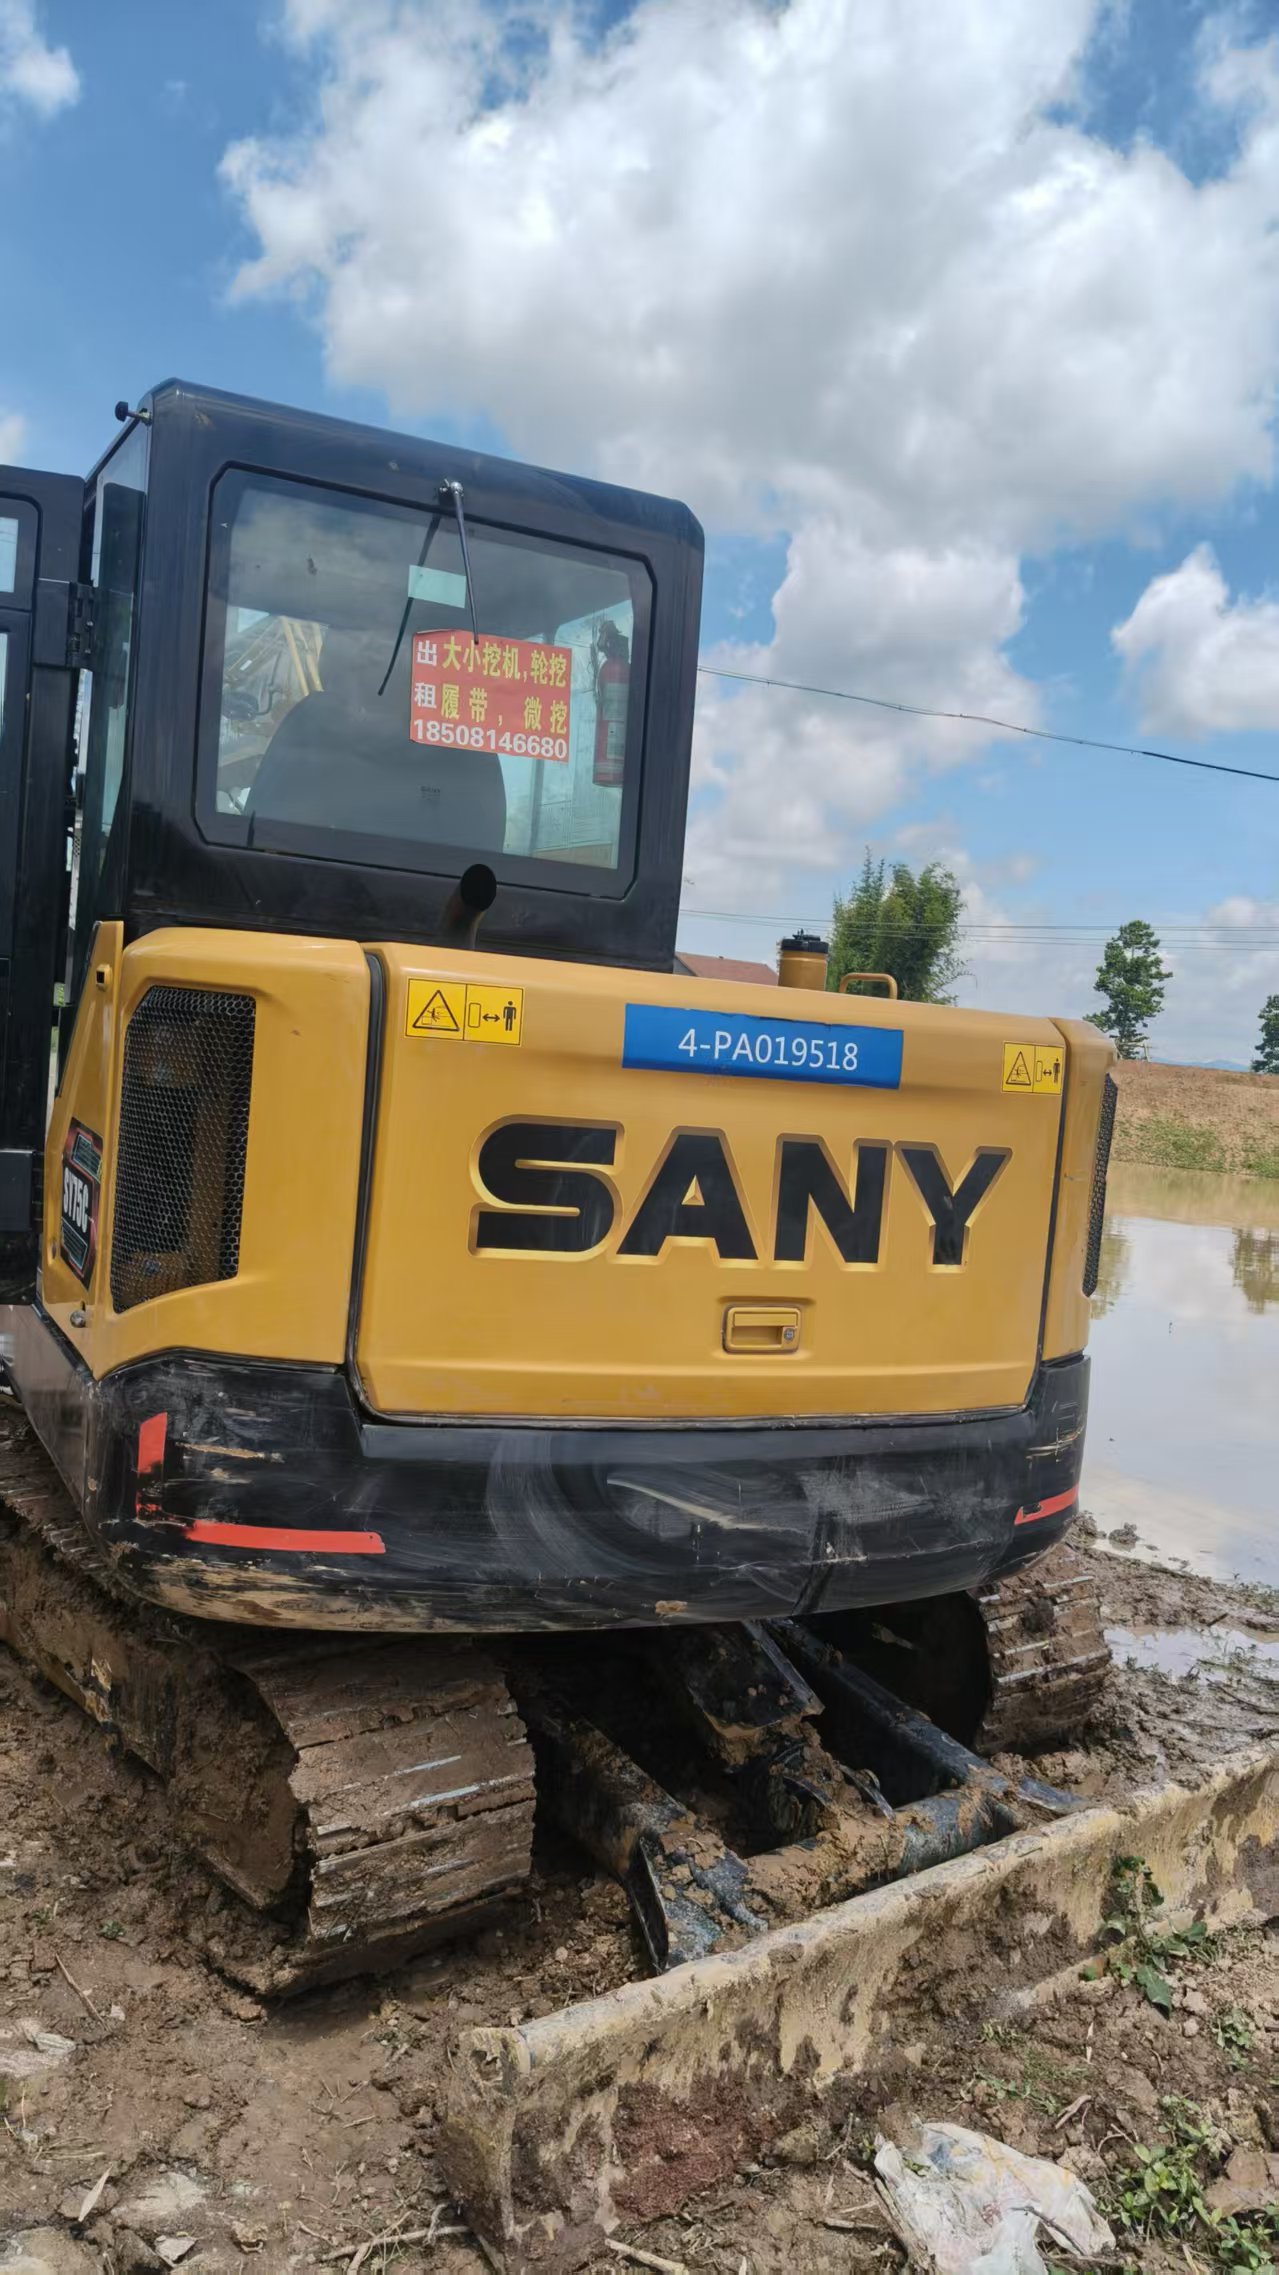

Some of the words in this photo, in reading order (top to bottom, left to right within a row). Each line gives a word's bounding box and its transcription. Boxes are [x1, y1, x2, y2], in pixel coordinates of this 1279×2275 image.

[413, 719, 568, 759] 18508146680
[678, 1028, 859, 1071] 4-PA019518
[63, 1166, 89, 1234] SY75C
[472, 1117, 1010, 1270] SANY
